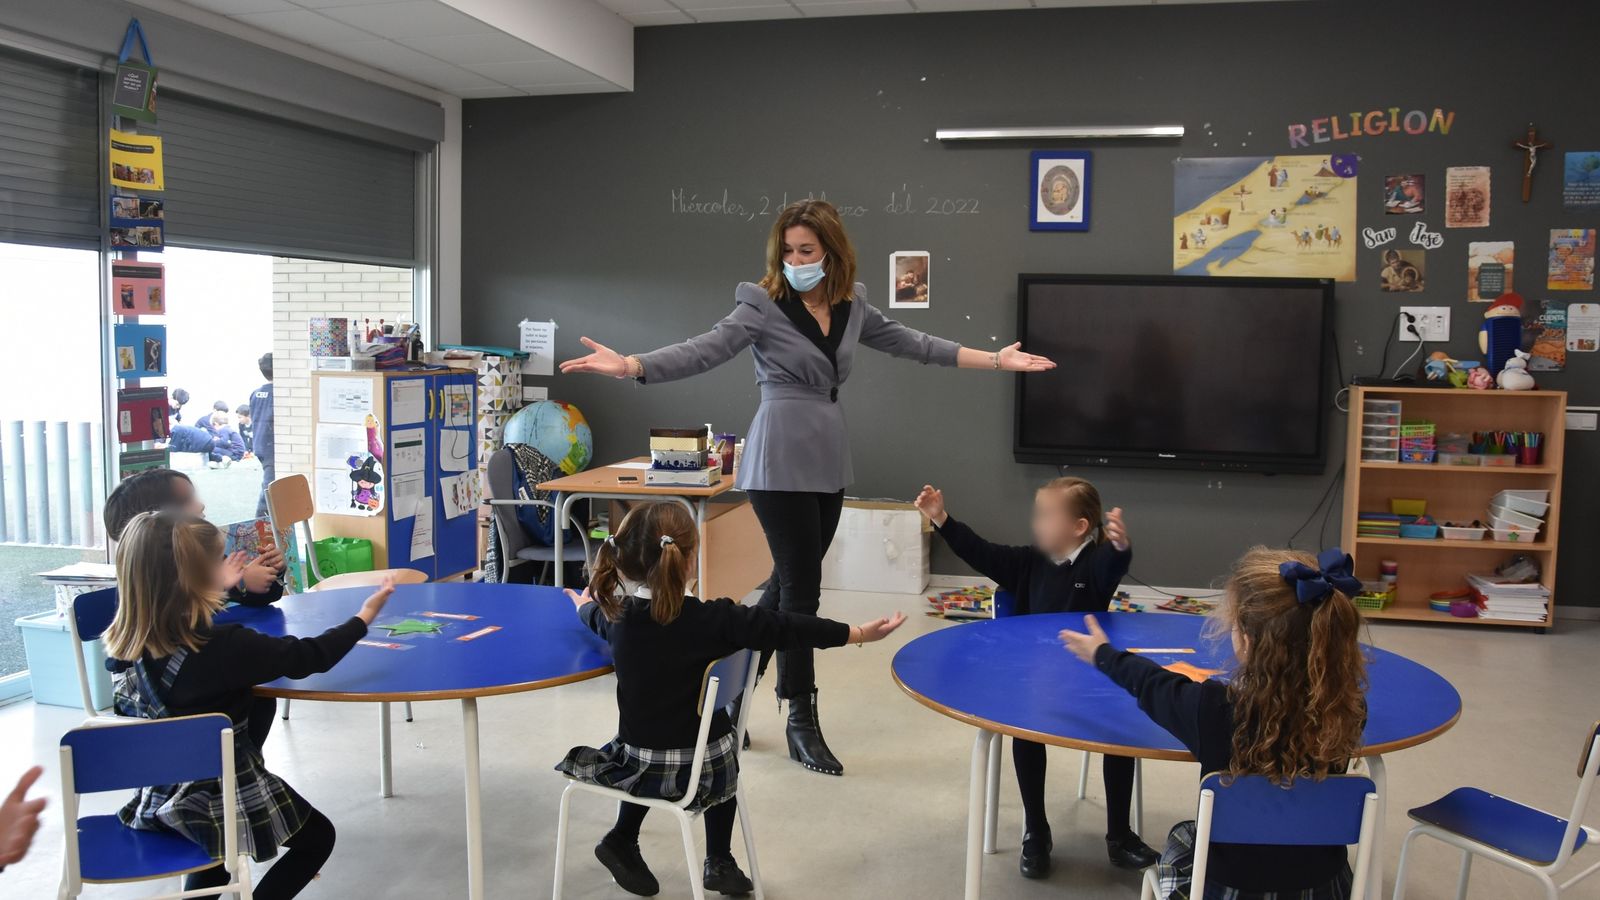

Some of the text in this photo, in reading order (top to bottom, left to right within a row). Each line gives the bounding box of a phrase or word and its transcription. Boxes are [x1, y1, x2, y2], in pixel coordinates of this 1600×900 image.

[1288, 107, 1455, 148] RELIGION
[671, 188, 755, 222] Miércoles,
[759, 195, 770, 215] 2
[926, 198, 980, 215] 2022
[1363, 222, 1444, 248] San José
[1539, 314, 1566, 322] CUENTA
